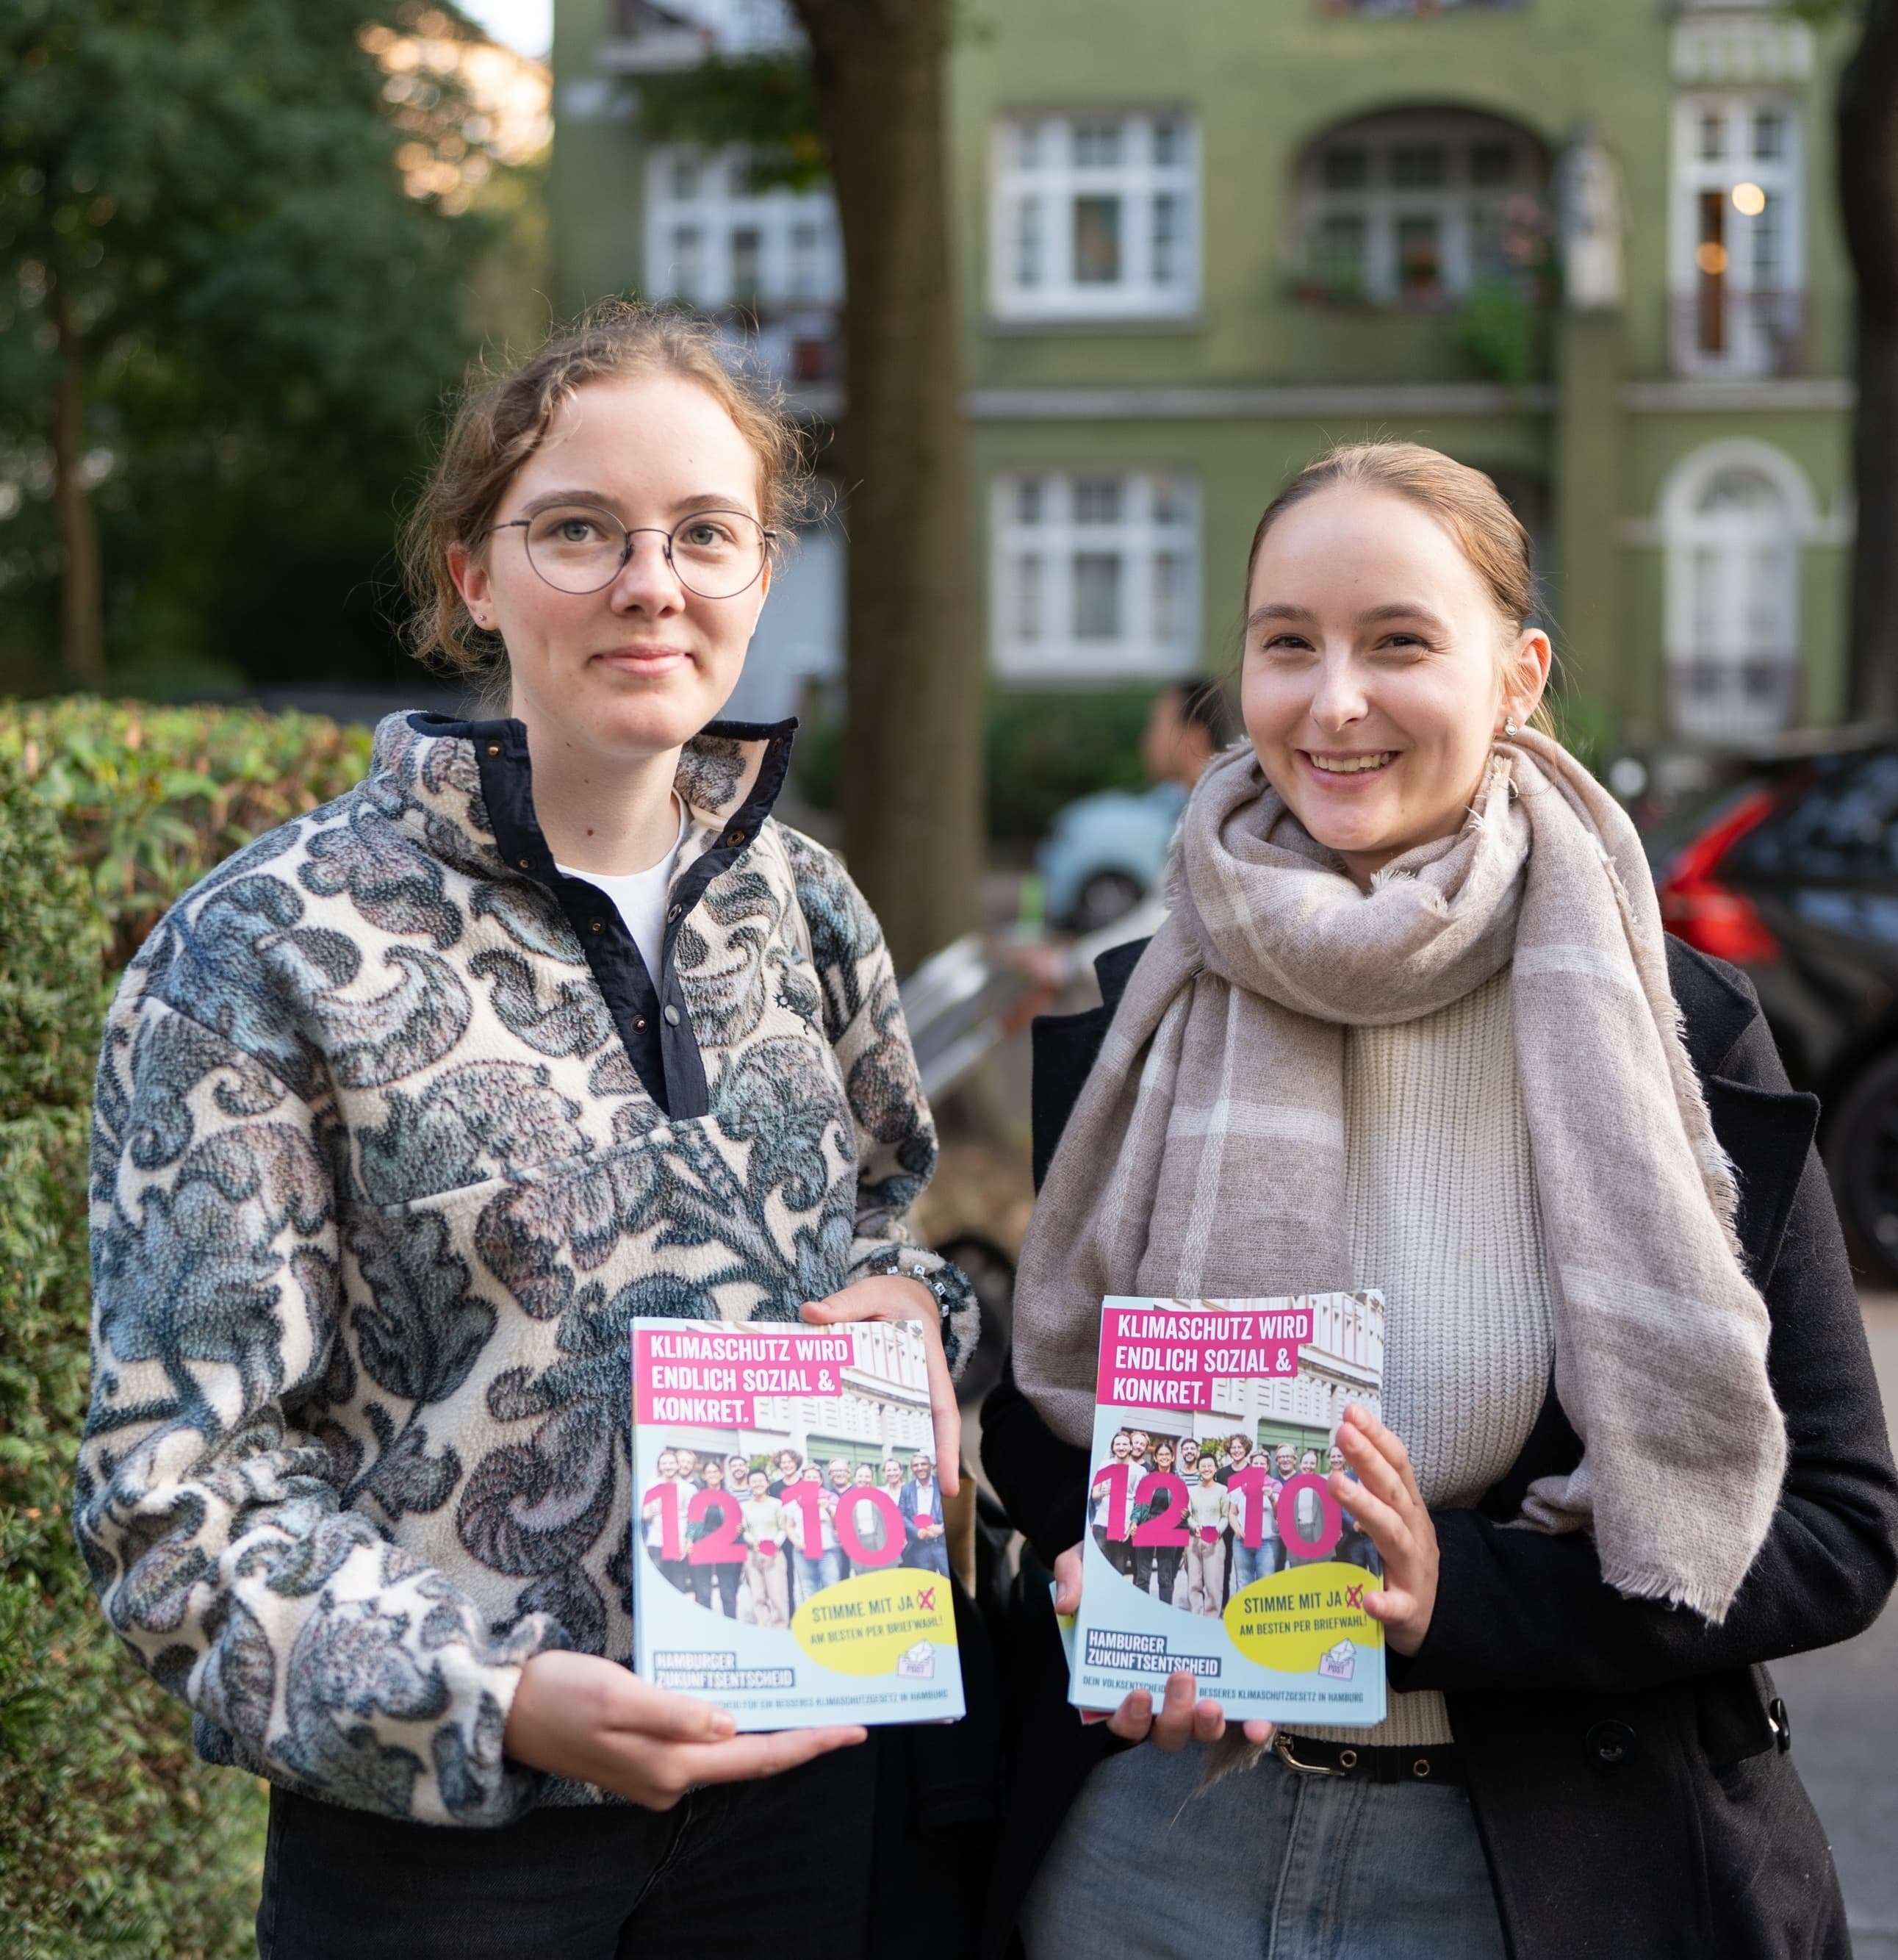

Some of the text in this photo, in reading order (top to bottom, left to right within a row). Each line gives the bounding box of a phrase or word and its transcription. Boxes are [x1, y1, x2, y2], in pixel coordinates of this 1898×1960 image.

[1118, 1315, 1308, 1340] KLIMASCHUTZ WIRD
[651, 1335, 849, 1362] KLIMASCHUTZ WIRD
[1115, 1346, 1292, 1373] ENDLICH SOZIAL &
[652, 1366, 835, 1392] ENDLICH SOZIAL &
[1113, 1377, 1206, 1405] KONKRET.
[653, 1397, 749, 1423] KONKRET.
[812, 1595, 914, 1623] STIMME MIT JA
[1244, 1591, 1342, 1614] STIMME MIT JA
[810, 1633, 824, 1645] AM
[828, 1628, 863, 1643] BESTEN
[866, 1625, 885, 1637] PER
[1240, 1615, 1367, 1636] AM BESTEN PER BRIEFWAHL!
[1088, 1630, 1165, 1654] HAMBURGER
[655, 1653, 735, 1670] HAMBURGER
[1088, 1648, 1218, 1676] ZUKUNFTSENTSCHEID
[1327, 1664, 1345, 1675] POST
[655, 1669, 793, 1689] ZUKUNFTSENTSCHEID
[1083, 1676, 1100, 1687] DEIN
[1199, 1687, 1364, 1703] BESSERES KLIMASCHUTZGESETZ IN HAMBURG
